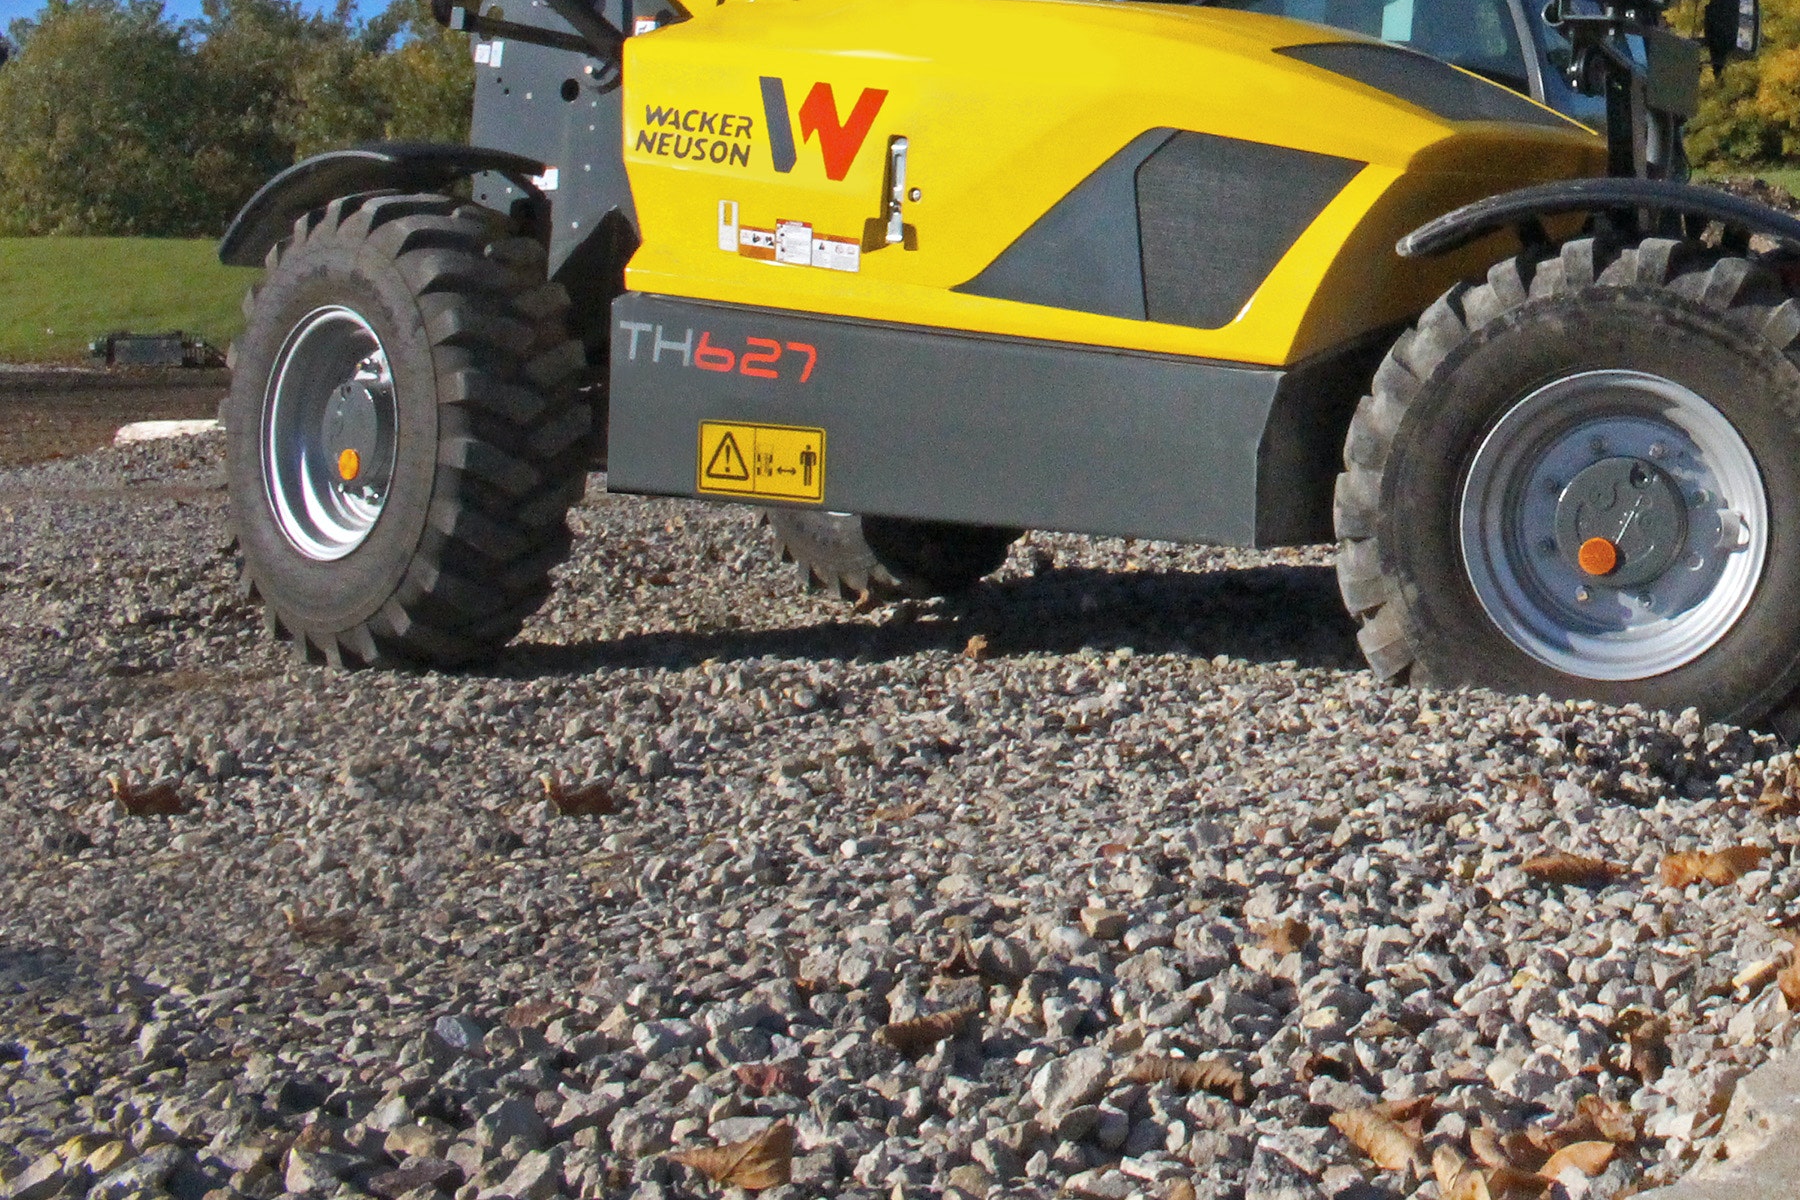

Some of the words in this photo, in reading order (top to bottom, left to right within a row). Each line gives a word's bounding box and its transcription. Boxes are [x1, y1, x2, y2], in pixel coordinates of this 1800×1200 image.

[645, 104, 753, 139] WACKER
[635, 129, 752, 167] NEUSON
[619, 320, 817, 383] TH627
